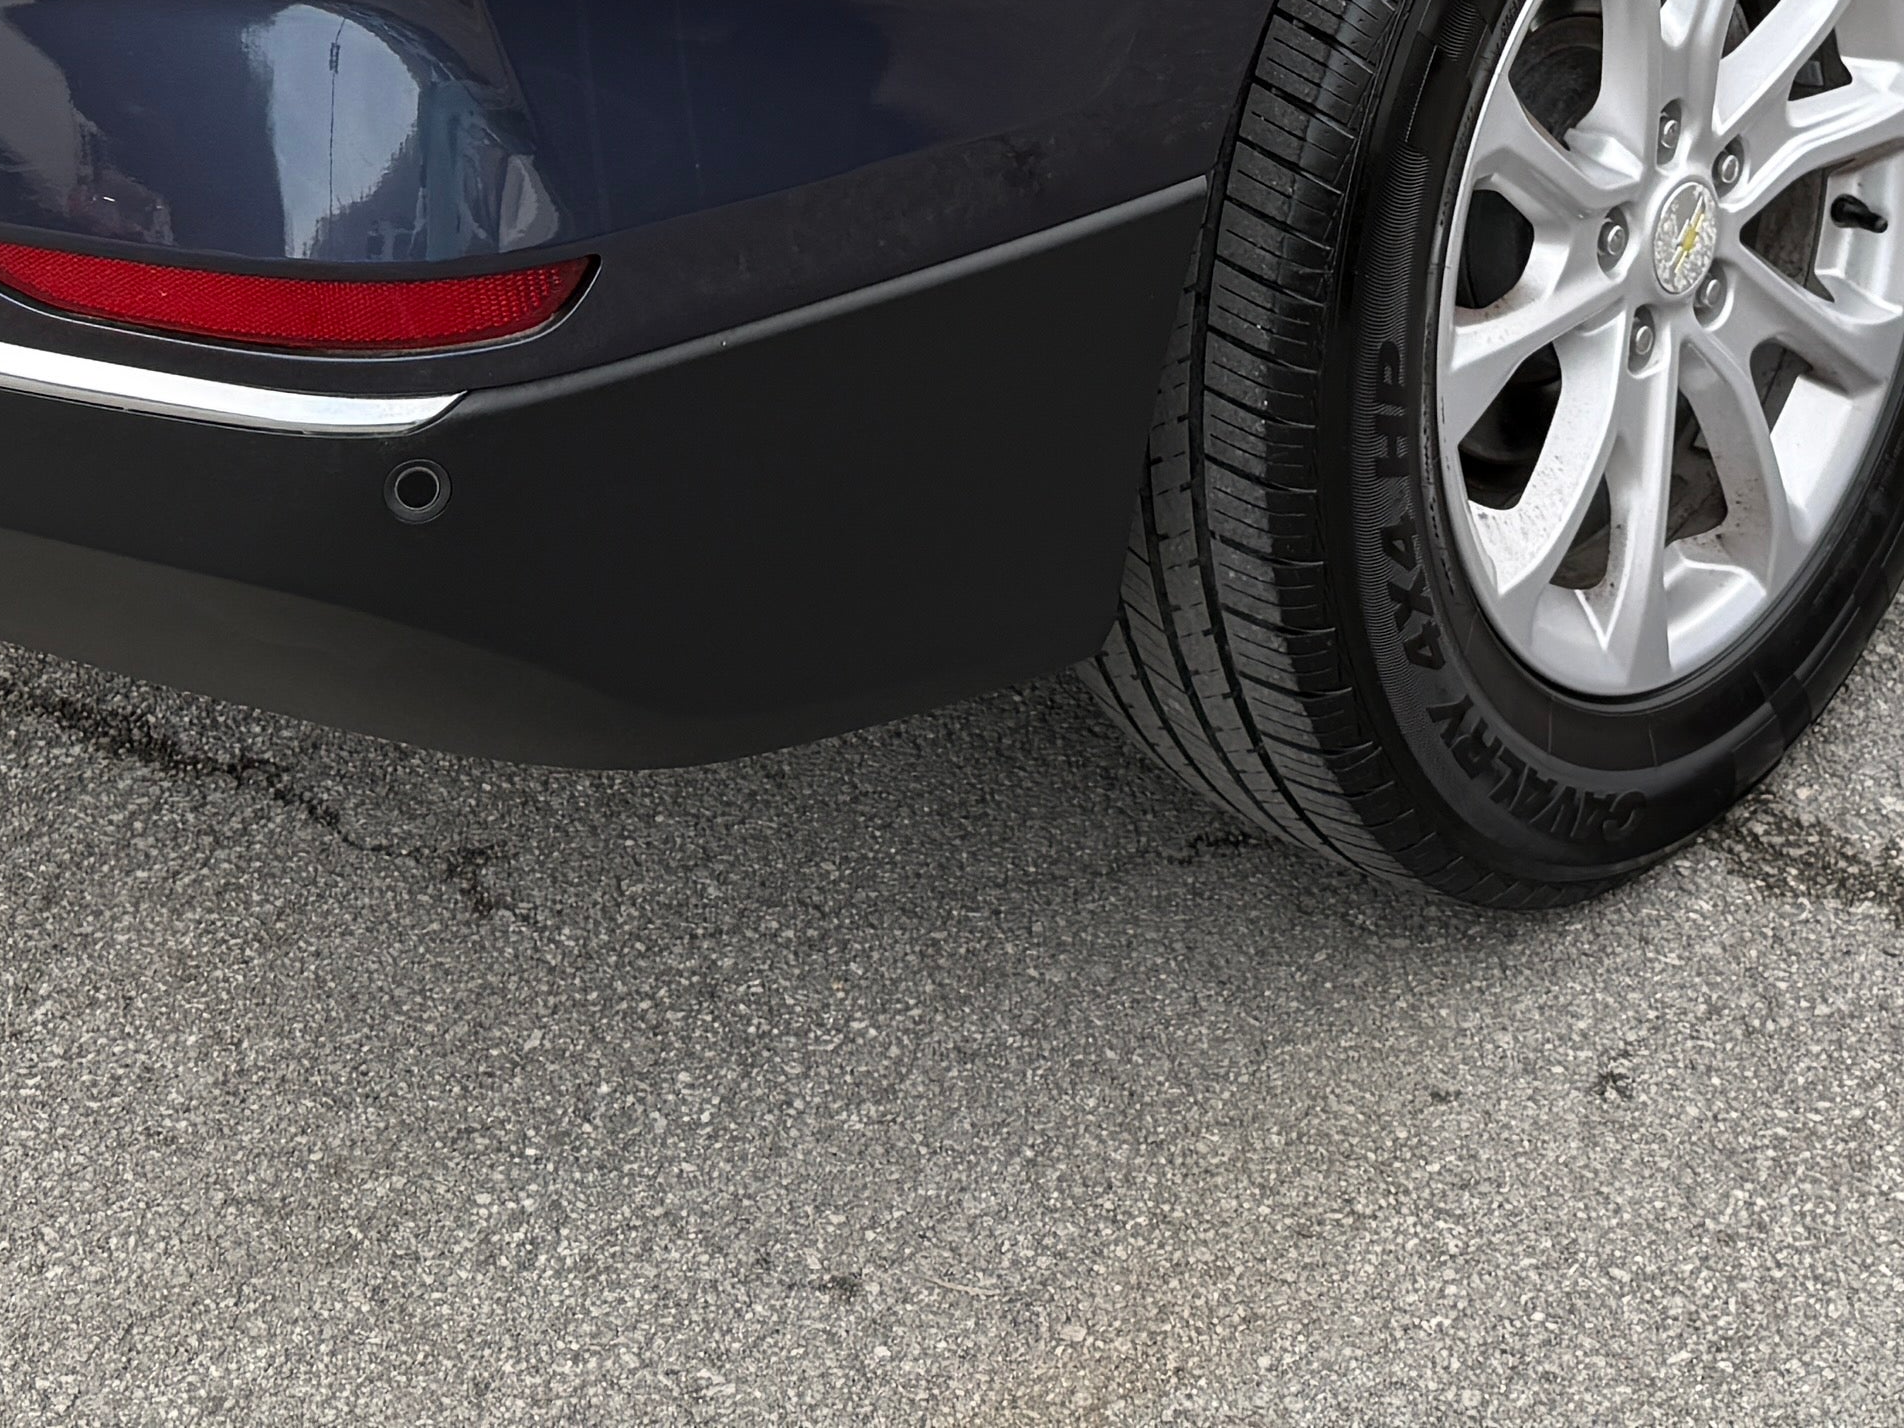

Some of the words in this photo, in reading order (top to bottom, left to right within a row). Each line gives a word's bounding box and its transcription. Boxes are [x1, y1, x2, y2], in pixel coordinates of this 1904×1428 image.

[1374, 340, 1410, 479] HP
[1379, 510, 1446, 670] 4X4
[1426, 695, 1648, 842] CAVALRY
